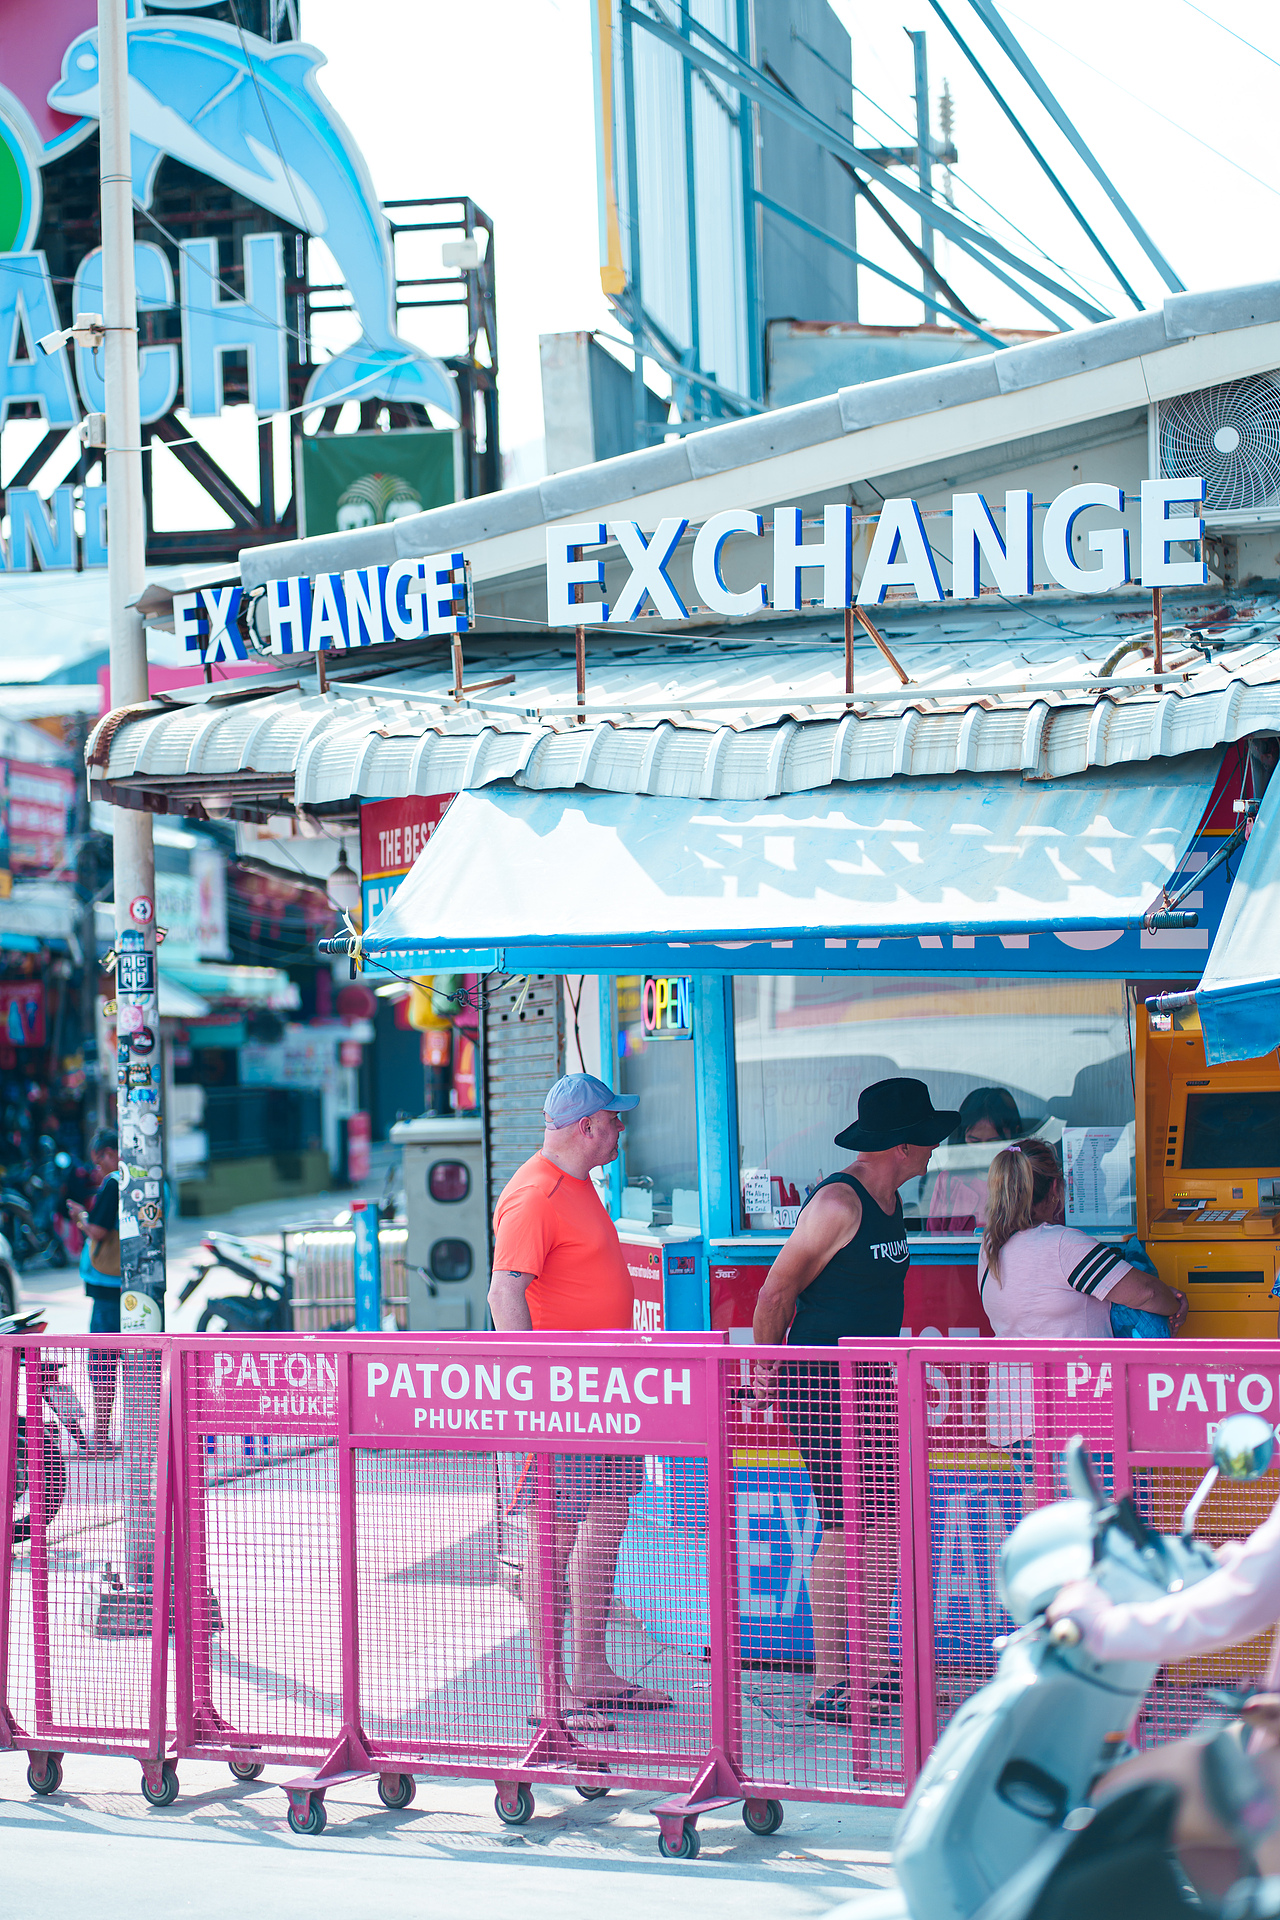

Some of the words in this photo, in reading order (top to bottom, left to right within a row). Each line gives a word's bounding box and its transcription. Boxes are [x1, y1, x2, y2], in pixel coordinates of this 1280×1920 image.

[546, 478, 1207, 626] EXCHANGE
[379, 828, 402, 867] THE
[643, 977, 690, 1030] OPEN
[633, 1299, 661, 1331] RATE
[367, 1363, 533, 1400] PATONG
[550, 1366, 692, 1405] BEACH
[1148, 1373, 1280, 1412] PATO
[260, 1395, 338, 1415] PHUKE
[414, 1408, 507, 1431] PHUKET
[515, 1410, 641, 1434] THAILAND
